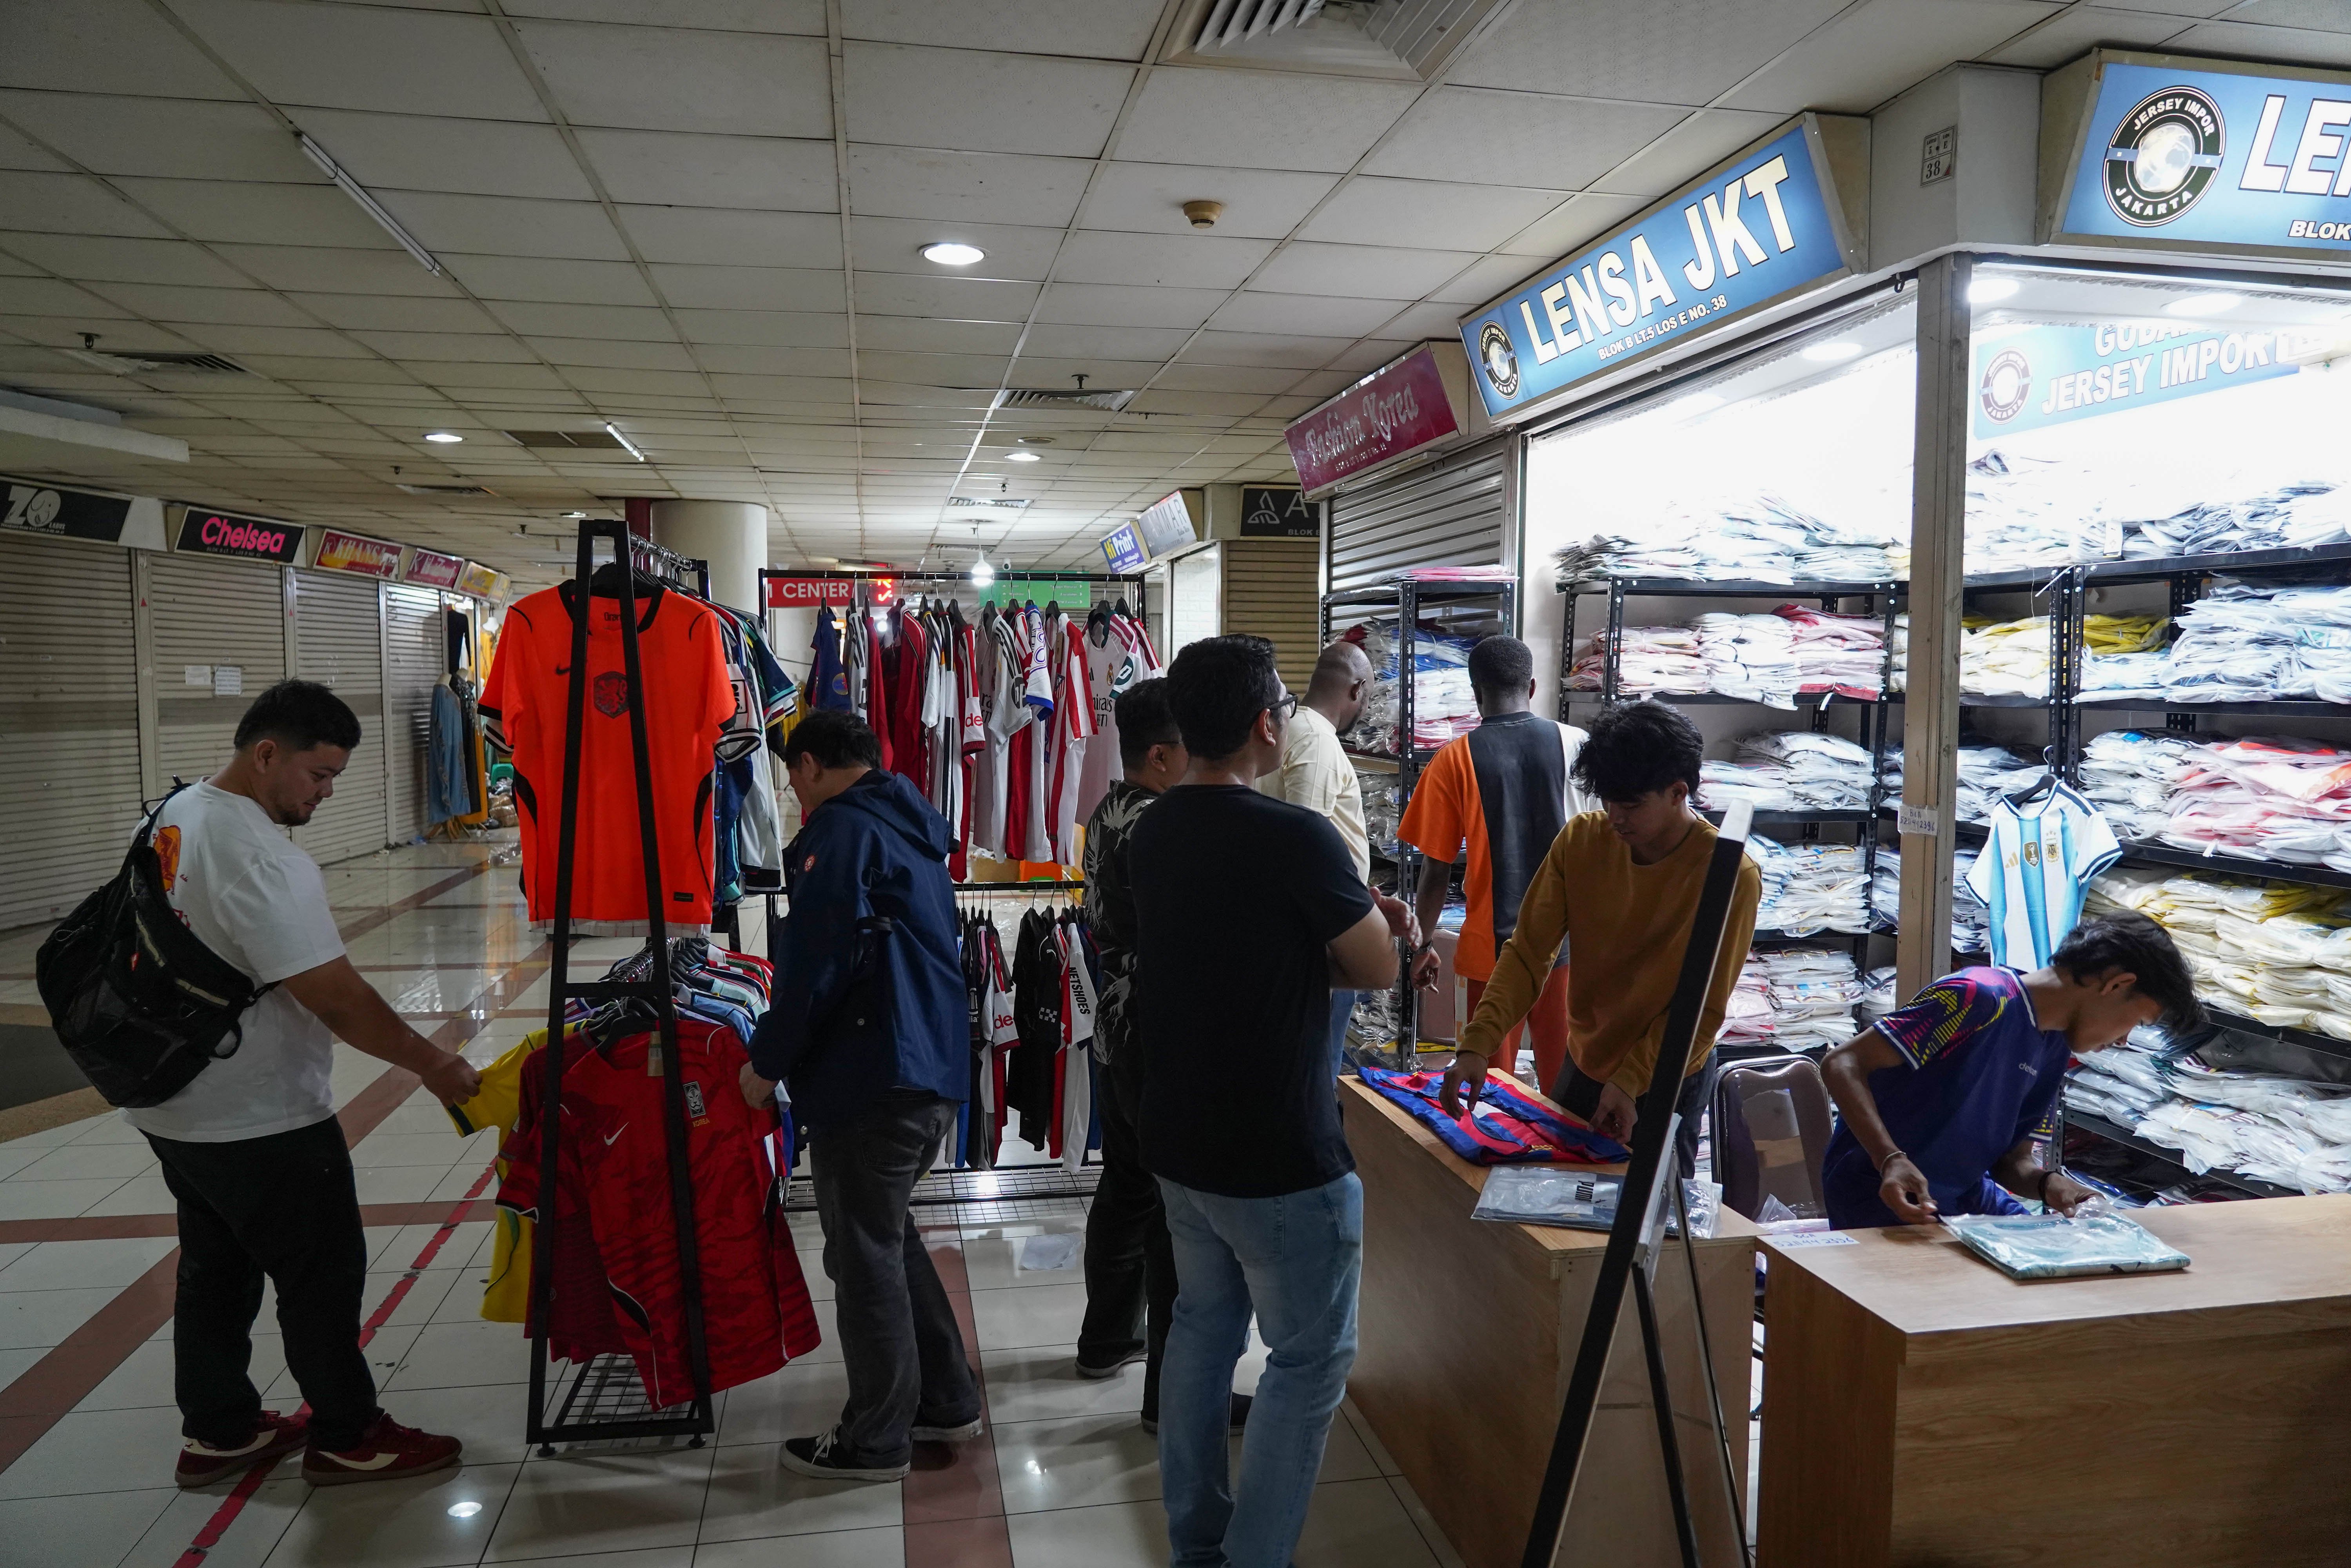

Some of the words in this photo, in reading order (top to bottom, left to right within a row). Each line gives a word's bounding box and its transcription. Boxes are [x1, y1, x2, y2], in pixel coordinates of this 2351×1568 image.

[2133, 97, 2184, 131] JERSEY
[2184, 100, 2215, 137] IMPOR
[1928, 146, 1932, 155] 5
[2238, 94, 2351, 198] LE
[1926, 160, 1941, 179] 38
[2115, 187, 2192, 216] JAKARTA
[2288, 220, 2351, 241] BLOK
[1519, 234, 1677, 365] LENSA
[1683, 153, 1796, 291] JKT
[1482, 328, 1490, 352] JERSEY
[1490, 327, 1505, 343] IMPOR
[1597, 339, 1626, 360] BLOK
[1624, 334, 1634, 349] B
[1633, 326, 1656, 345] LT.5
[1655, 316, 1678, 336] LOS
[1677, 310, 1688, 326] E
[1687, 303, 1711, 321] NO.
[1710, 294, 1728, 311] 38
[1495, 373, 1517, 393] JAKARTA
[2041, 353, 2154, 416] JERSEY
[1363, 383, 1419, 441] Korea
[1987, 399, 2023, 418] JAKARTA
[201, 516, 286, 554] Chelsea
[782, 582, 849, 598] CENTER
[1069, 967, 1091, 1014] NETSHOES
[994, 1014, 1014, 1029] de
[692, 1118, 710, 1128] KOREA
